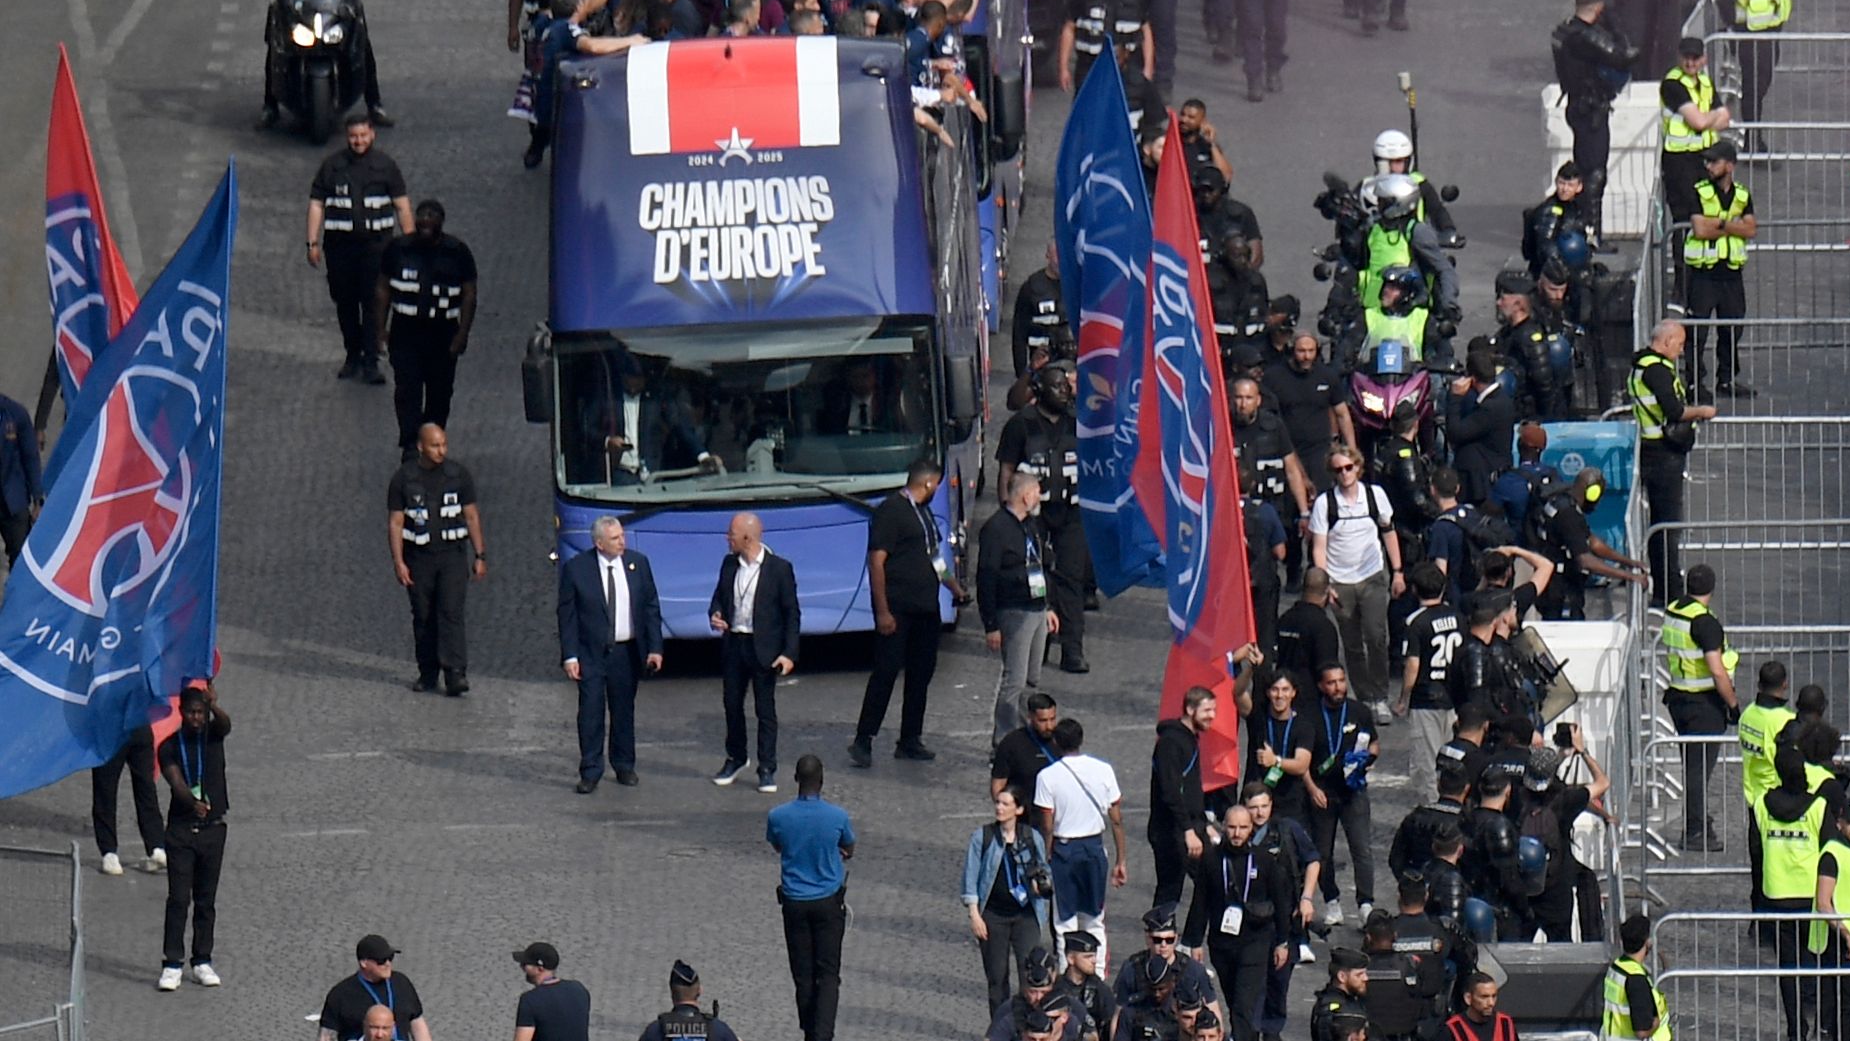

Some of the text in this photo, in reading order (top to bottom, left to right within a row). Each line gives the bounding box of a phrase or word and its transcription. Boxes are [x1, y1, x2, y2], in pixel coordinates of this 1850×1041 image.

[688, 150, 783, 167] 2024 2025
[639, 175, 834, 230] CHAMPIONS
[653, 223, 826, 284] D'EUROPE
[1430, 631, 1463, 668] 20
[665, 1022, 708, 1034] POLICE
